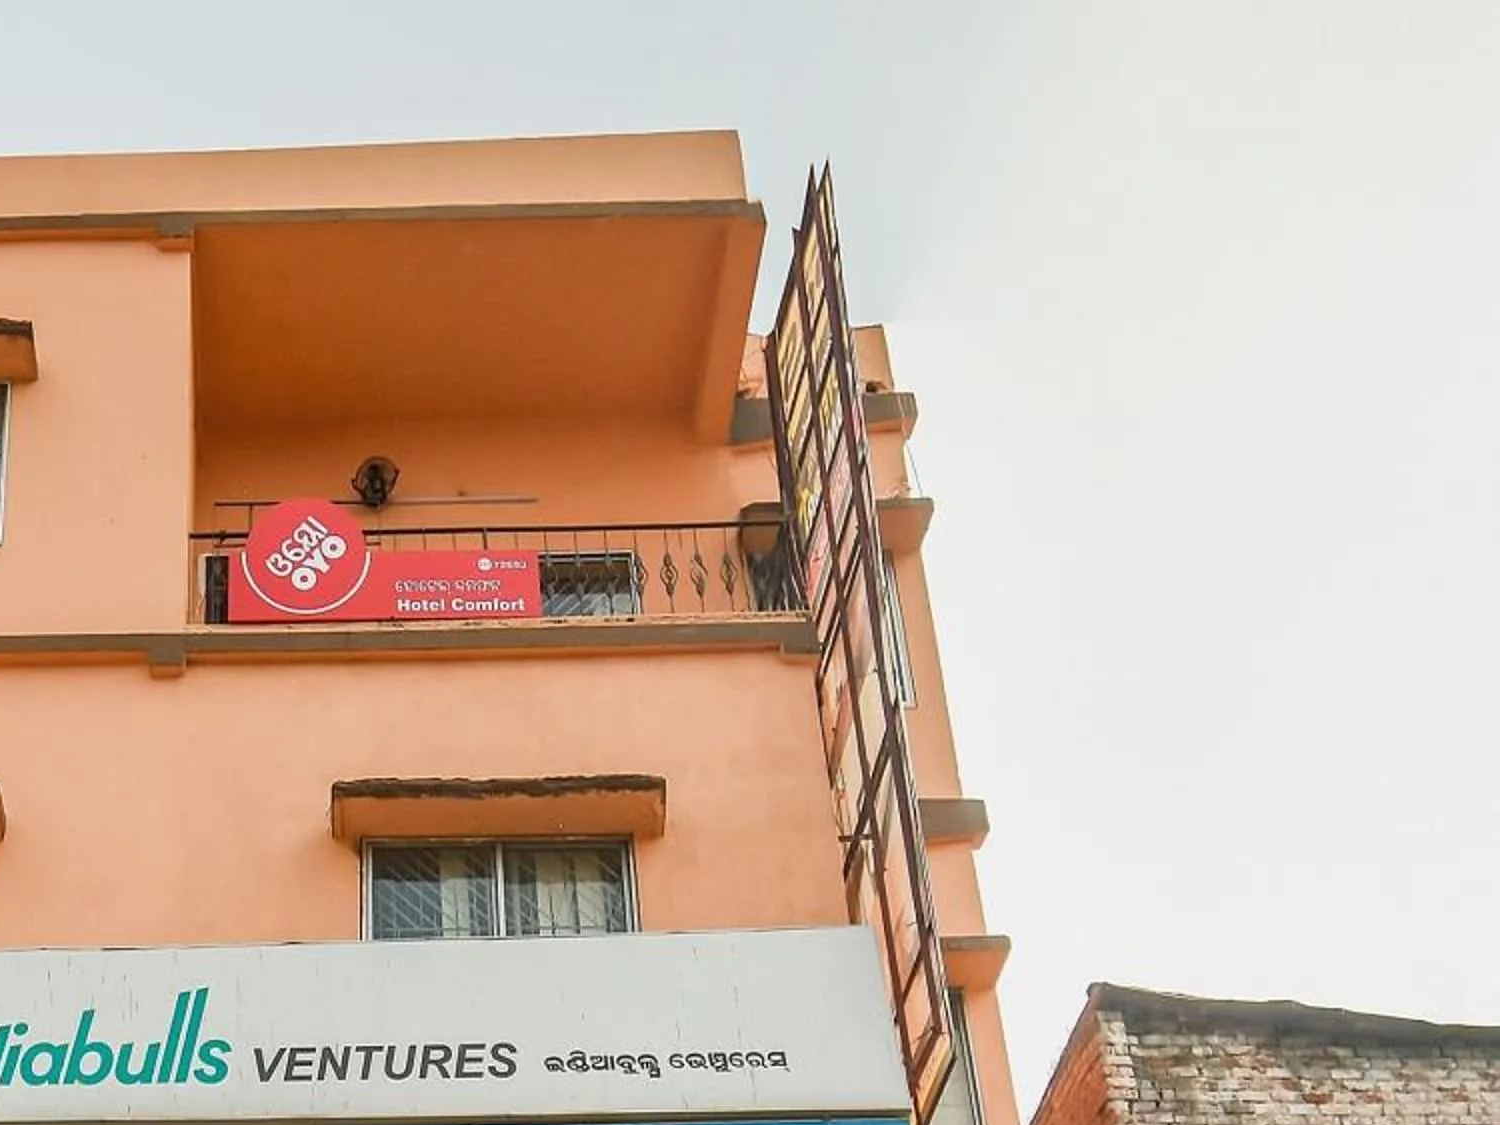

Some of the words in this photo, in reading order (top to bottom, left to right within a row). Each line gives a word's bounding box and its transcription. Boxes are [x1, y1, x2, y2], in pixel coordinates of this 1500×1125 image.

[291, 535, 346, 591] OYO
[397, 597, 445, 612] Hotel
[451, 597, 525, 612] Comfort
[253, 1042, 518, 1083] VENTURES
